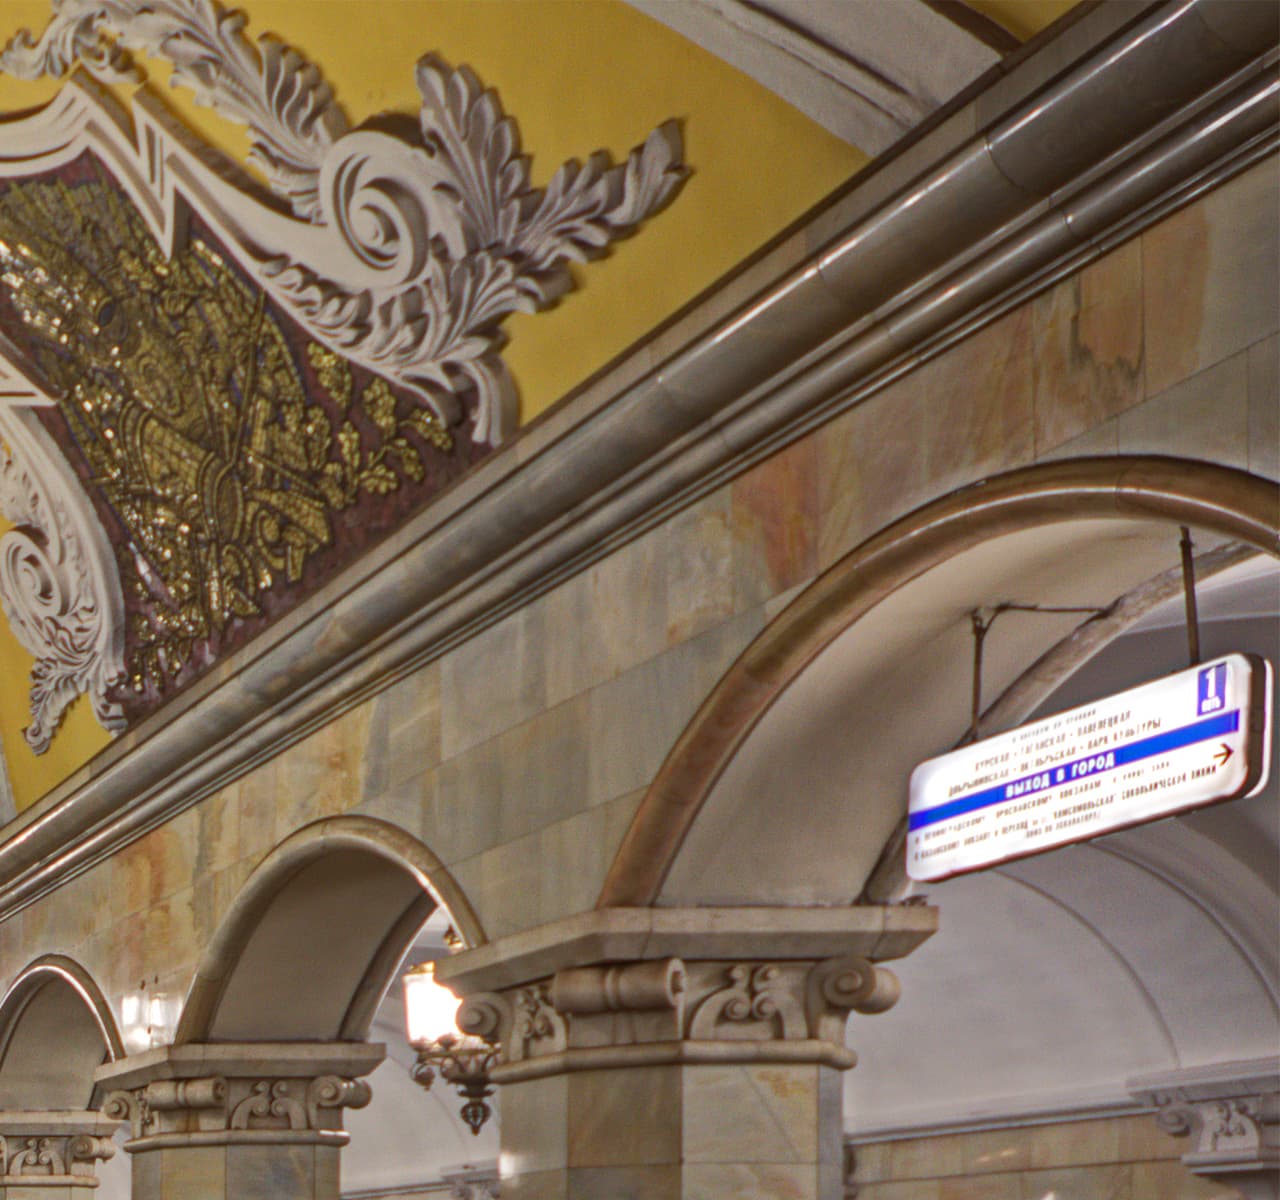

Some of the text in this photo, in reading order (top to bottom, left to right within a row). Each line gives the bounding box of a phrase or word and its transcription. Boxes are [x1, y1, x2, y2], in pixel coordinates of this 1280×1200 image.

[1206, 668, 1216, 698] 1
[1006, 773, 1050, 799] ВЫХОД
[1056, 769, 1065, 784] В
[1072, 752, 1115, 777] ГОРОД
